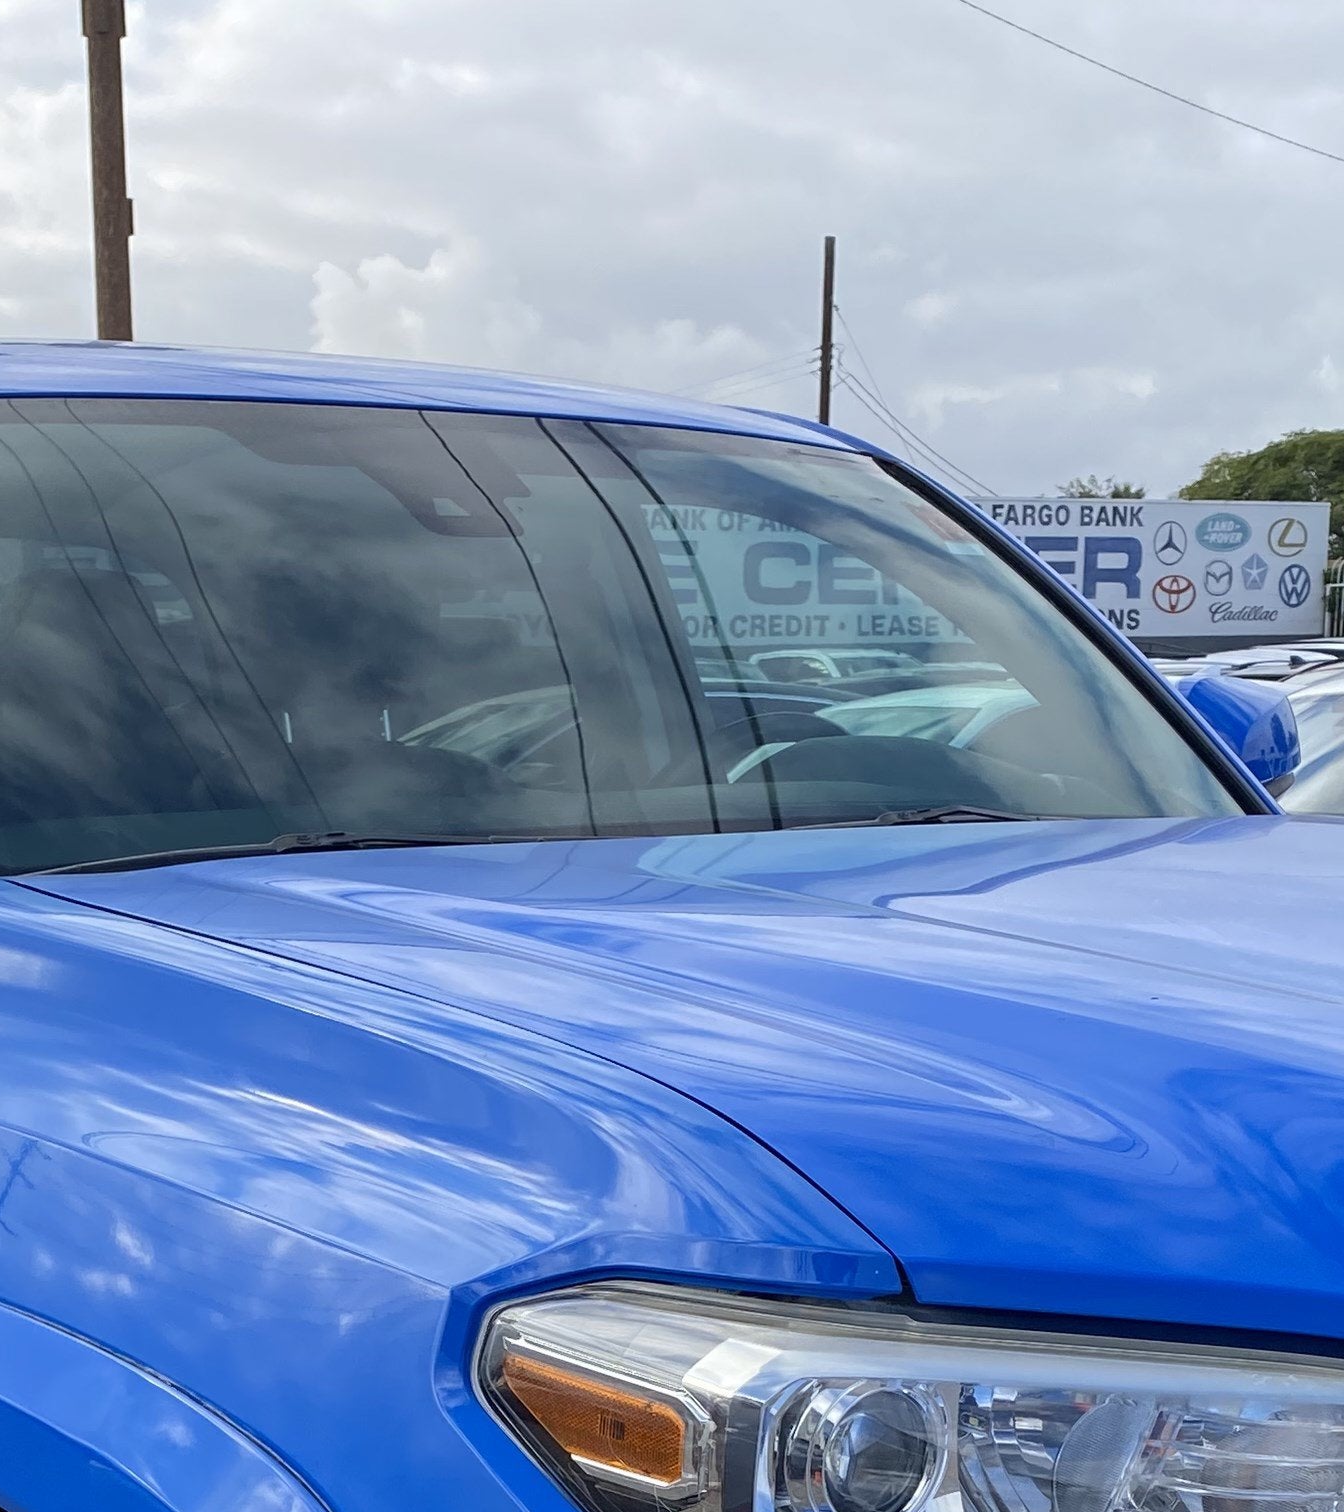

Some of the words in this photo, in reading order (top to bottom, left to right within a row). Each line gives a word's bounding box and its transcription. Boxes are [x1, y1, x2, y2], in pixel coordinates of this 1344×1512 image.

[642, 508, 707, 532] ANK
[992, 504, 1071, 527] FARGO
[1080, 505, 1144, 527] BANK
[1208, 601, 1279, 624] Cadillac
[729, 614, 831, 638] CREDIT
[857, 615, 940, 637] LEASE
